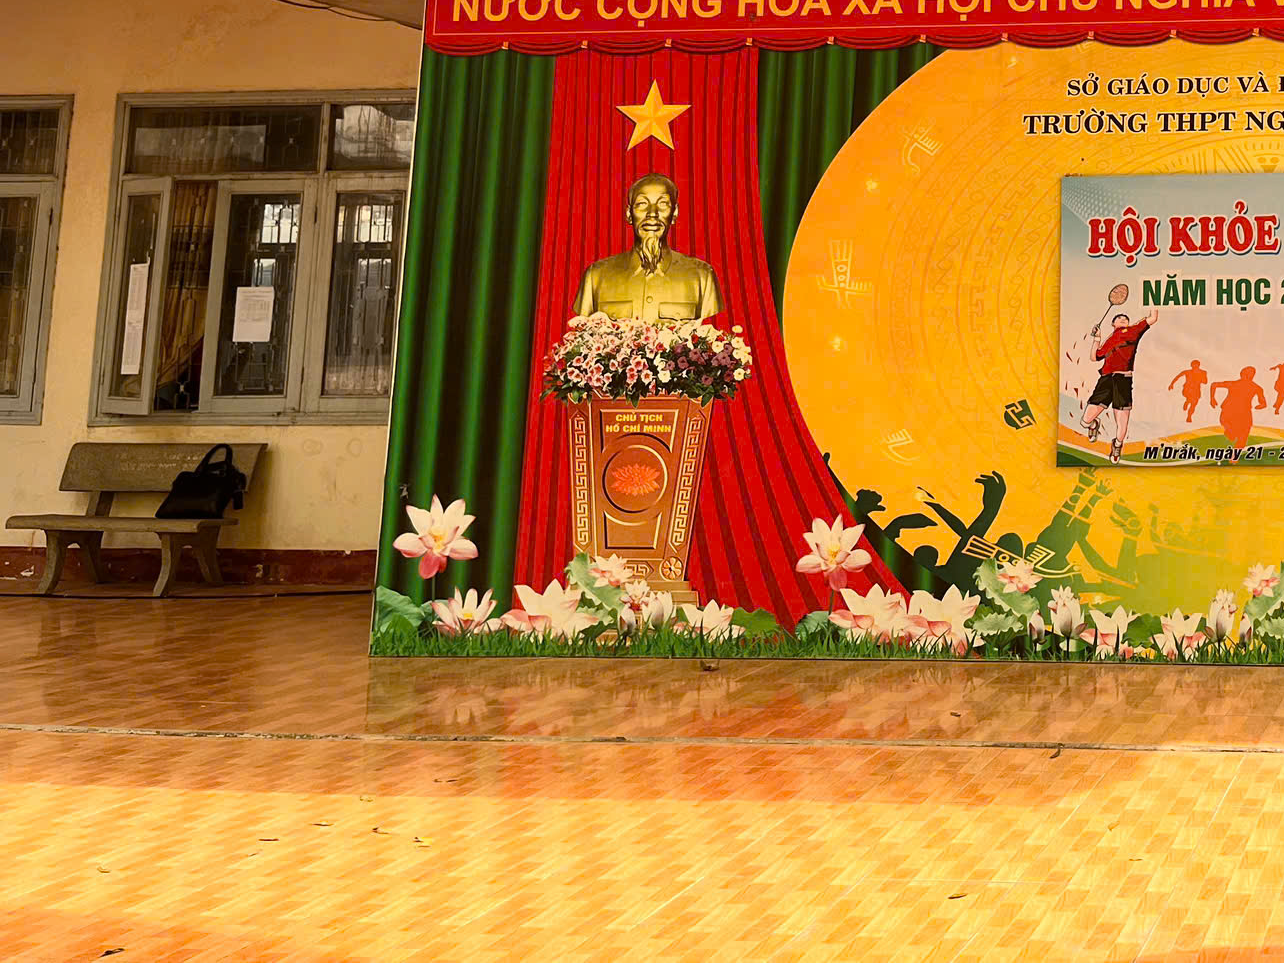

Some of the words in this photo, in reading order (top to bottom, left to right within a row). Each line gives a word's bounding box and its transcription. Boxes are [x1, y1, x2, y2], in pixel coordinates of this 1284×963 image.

[1066, 72, 1100, 96] SỞ
[1107, 73, 1170, 96] GIÁO
[1176, 76, 1229, 98] DỤC
[1237, 71, 1270, 93] VÀ
[1023, 108, 1148, 135] TRƯỜNG
[1156, 111, 1237, 132] THPT
[1087, 205, 1161, 266] HỘI
[1168, 199, 1281, 256] KHỎE
[1142, 273, 1206, 307] NĂM
[1216, 277, 1271, 311] HỌC
[615, 411, 637, 422] CHỦ
[639, 414, 663, 424] TỊCH
[622, 422, 641, 433] CHÍ
[643, 424, 672, 433] MINH
[1205, 445, 1243, 462] ngày
[1245, 445, 1263, 460] 21
